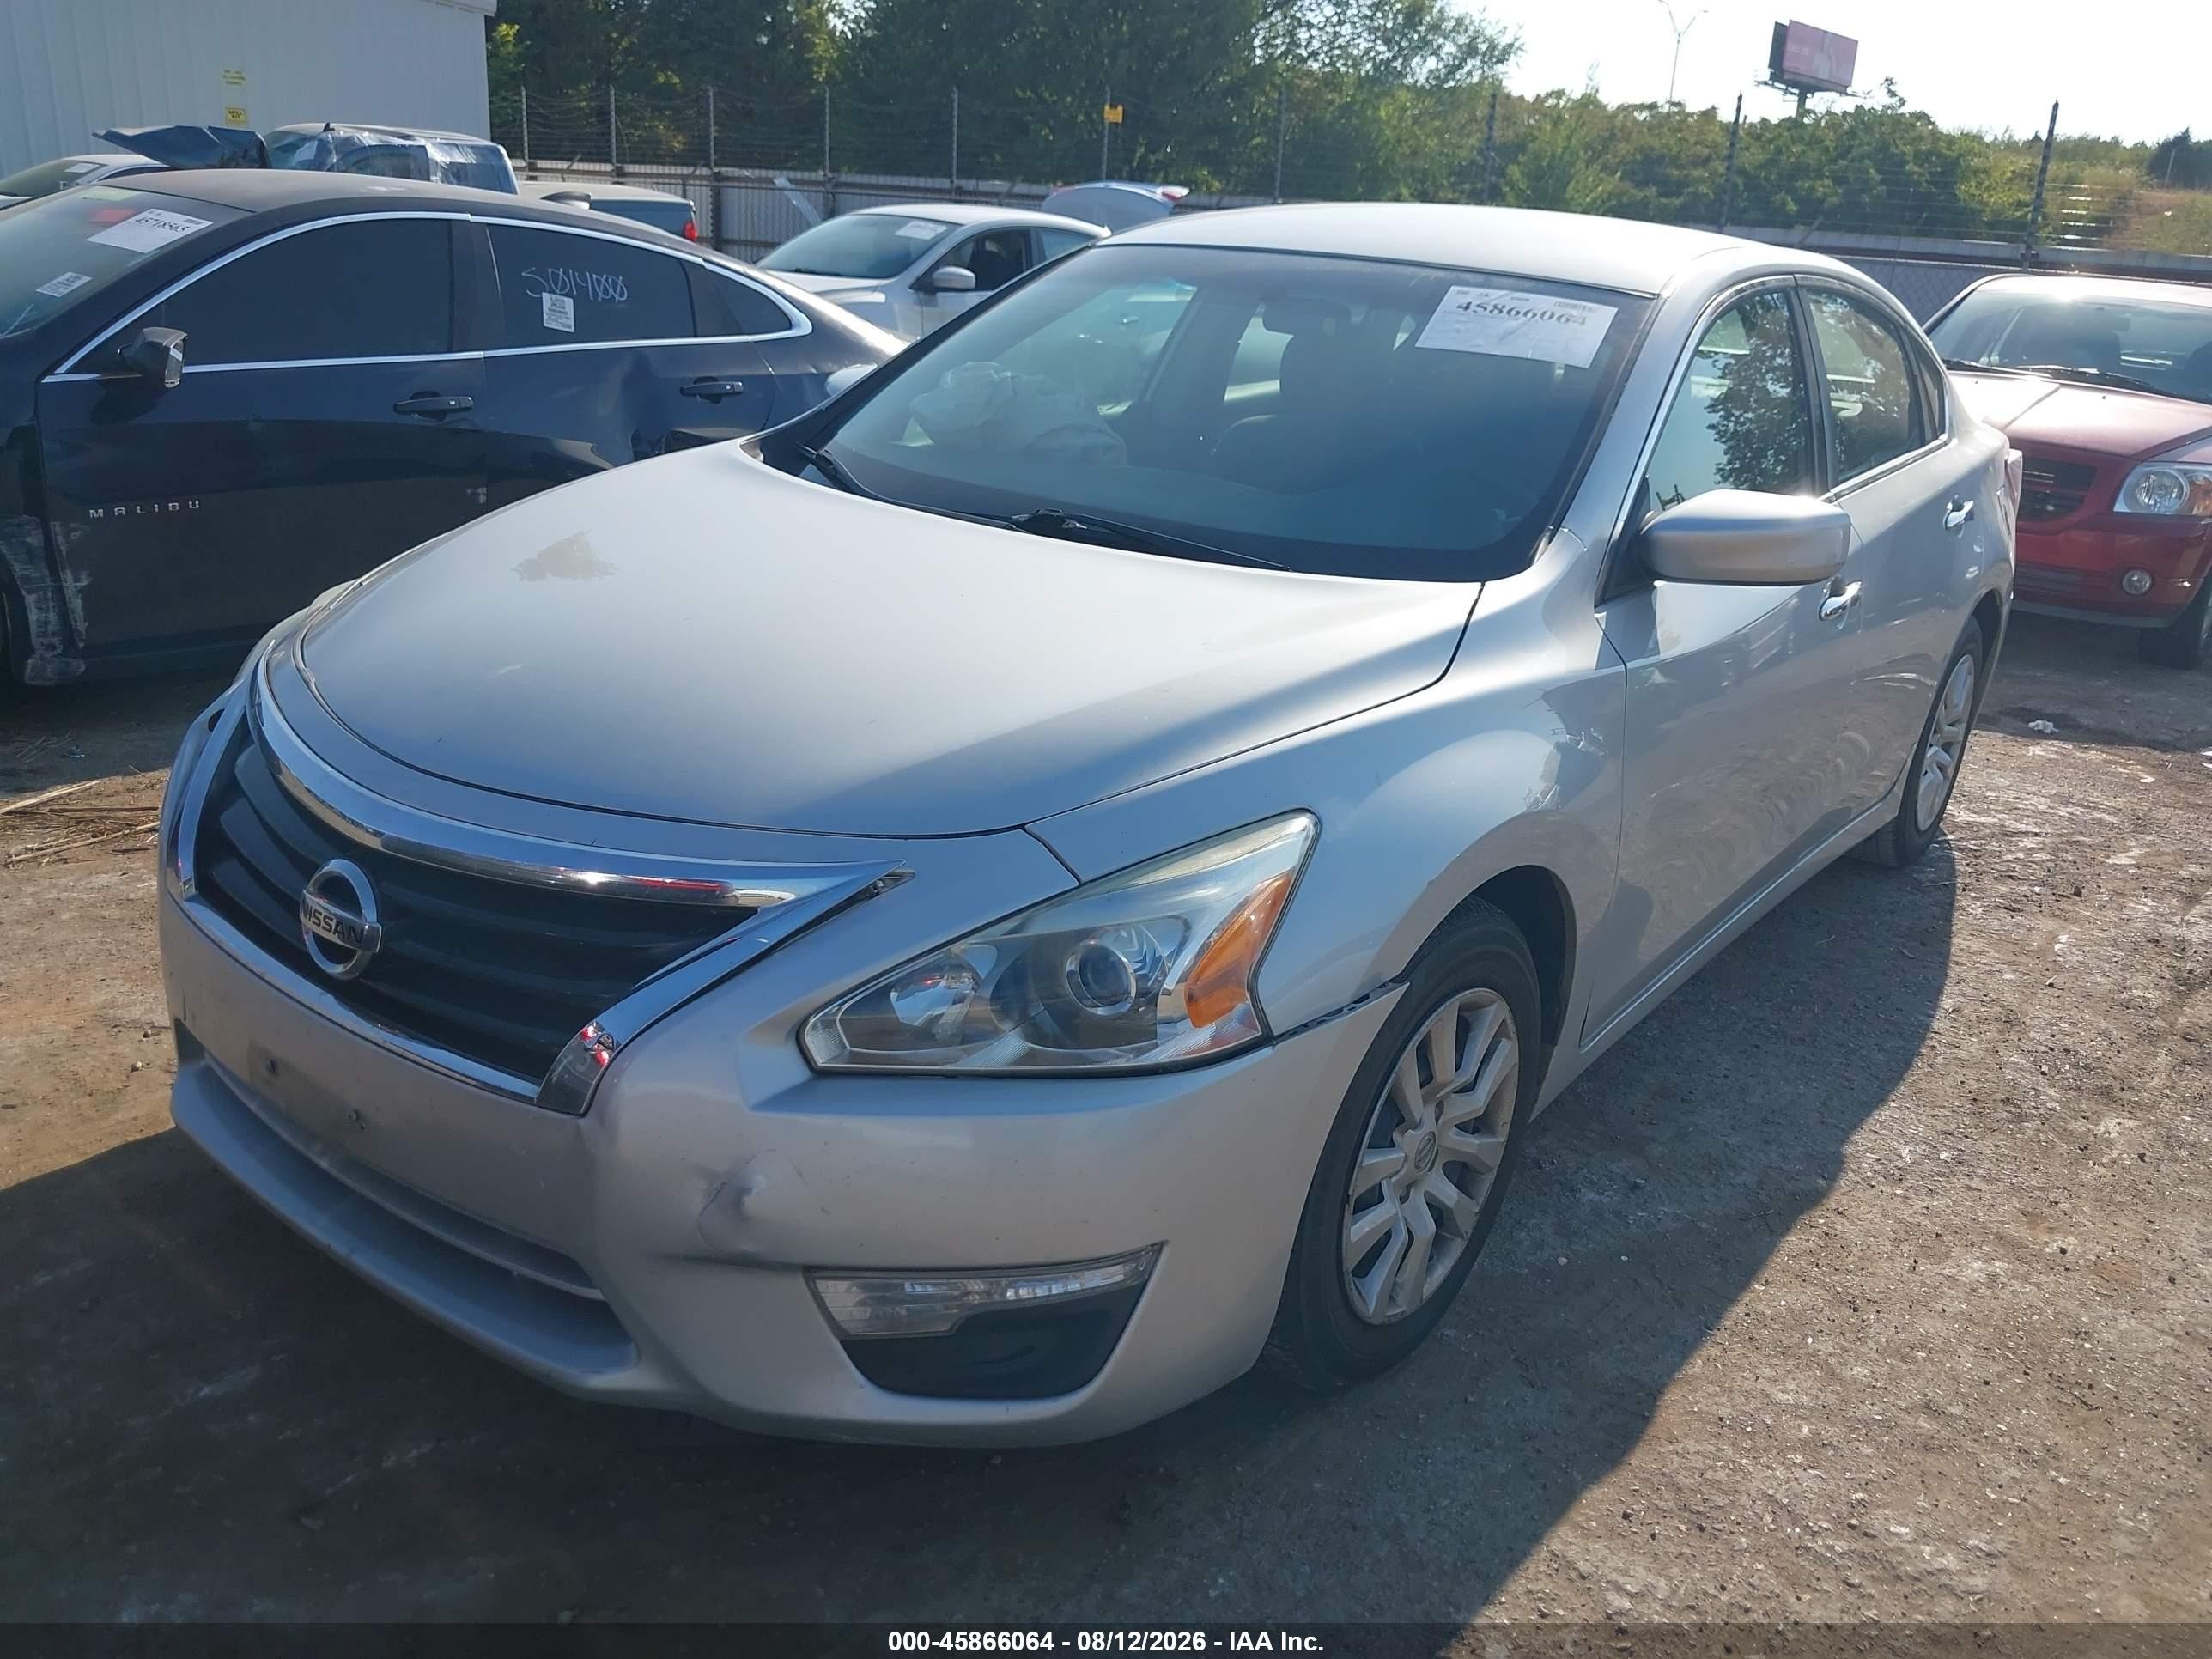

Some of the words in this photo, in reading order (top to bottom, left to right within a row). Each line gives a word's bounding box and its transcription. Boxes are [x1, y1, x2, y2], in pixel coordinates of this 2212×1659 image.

[1455, 301, 1588, 326] 45866064
[88, 500, 200, 519] MALIBU
[301, 897, 366, 945] NISSAN
